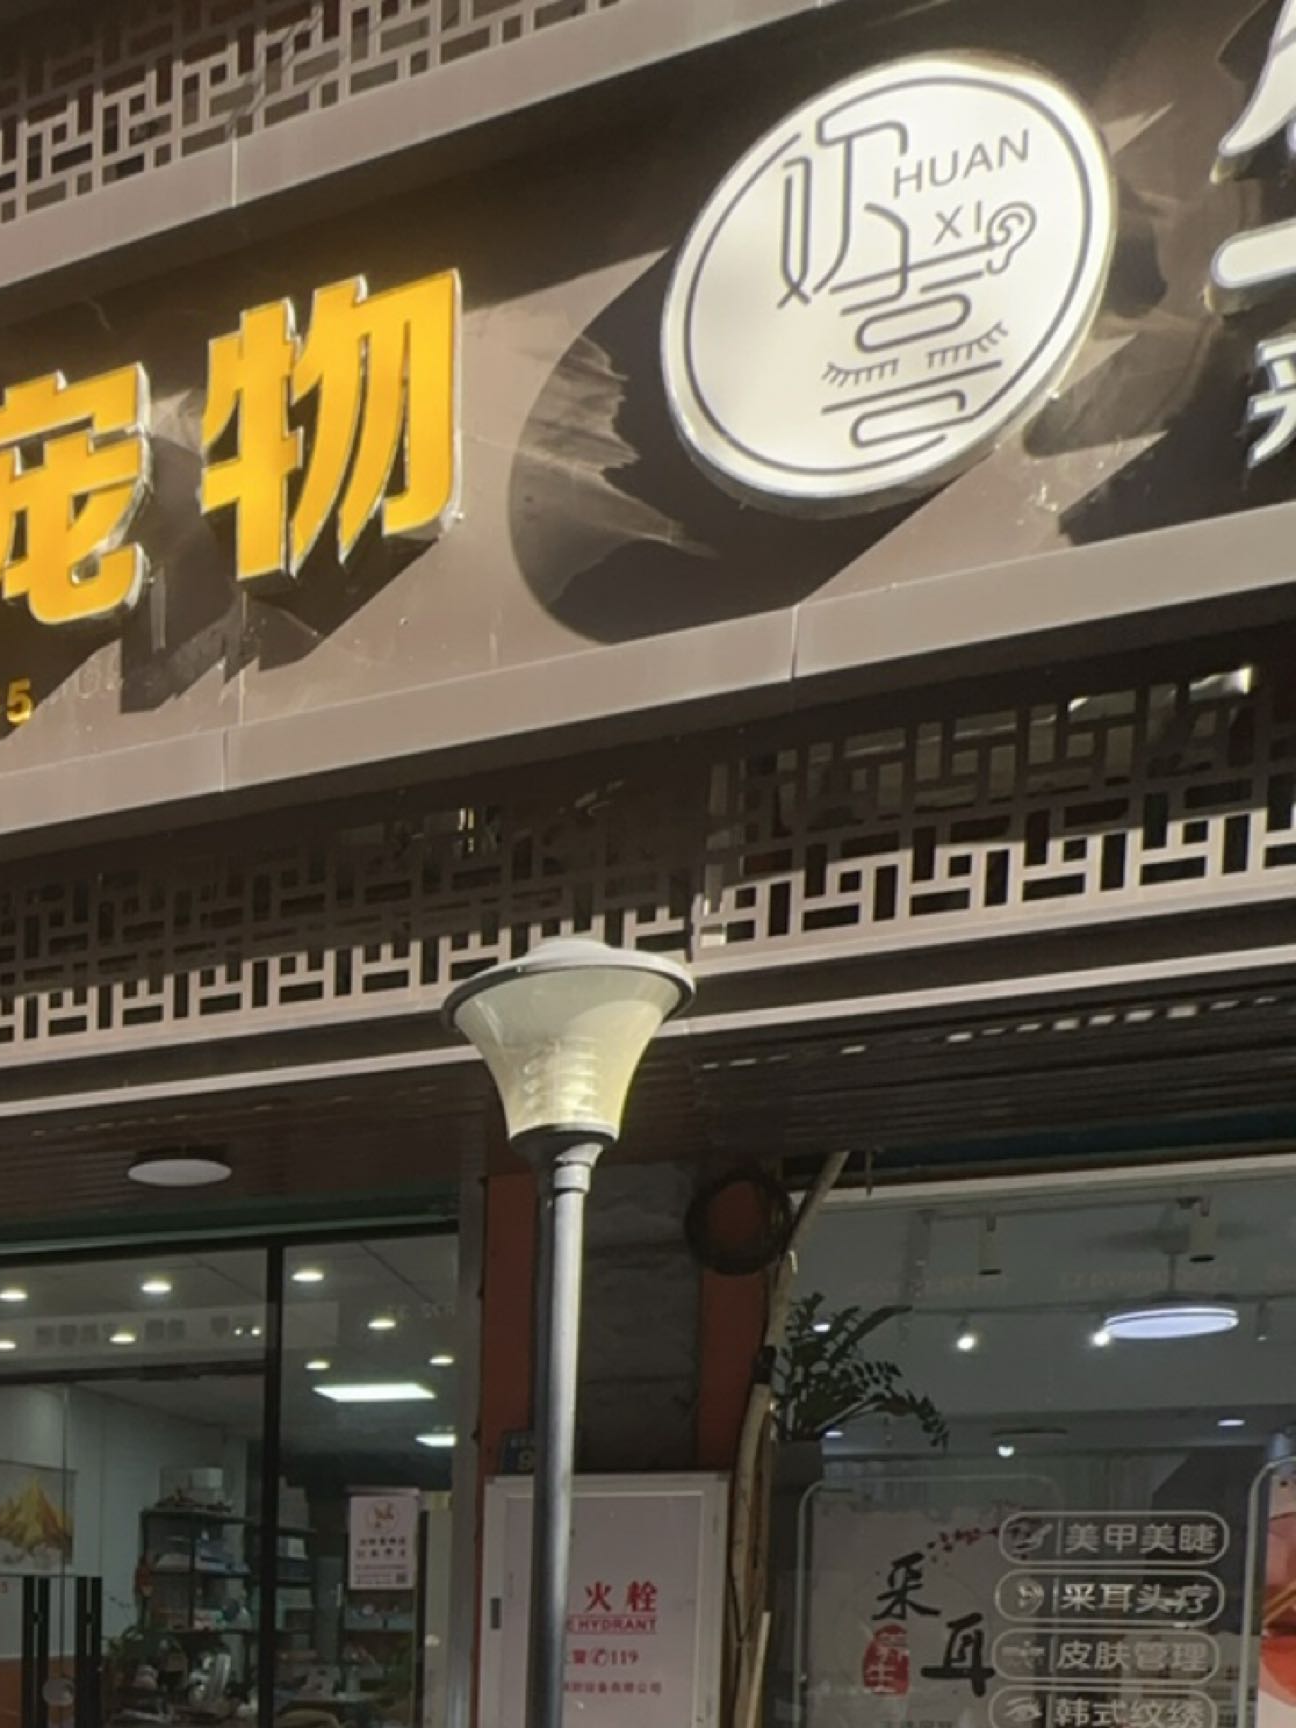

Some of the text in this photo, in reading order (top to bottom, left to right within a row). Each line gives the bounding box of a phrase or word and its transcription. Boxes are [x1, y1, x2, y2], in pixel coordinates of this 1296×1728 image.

[891, 128, 1031, 199] HUAN
[932, 200, 984, 245] XI
[1066, 1523, 1218, 1556] 美甲美睫
[1060, 1582, 1213, 1615] 采耳头疗
[577, 1619, 656, 1633] HYDRANT
[871, 1552, 995, 1697] 采耳
[611, 1649, 639, 1665] 119
[1056, 1640, 1208, 1672] 皮肤管理
[1054, 1698, 1204, 1728] 韩式纹绣
